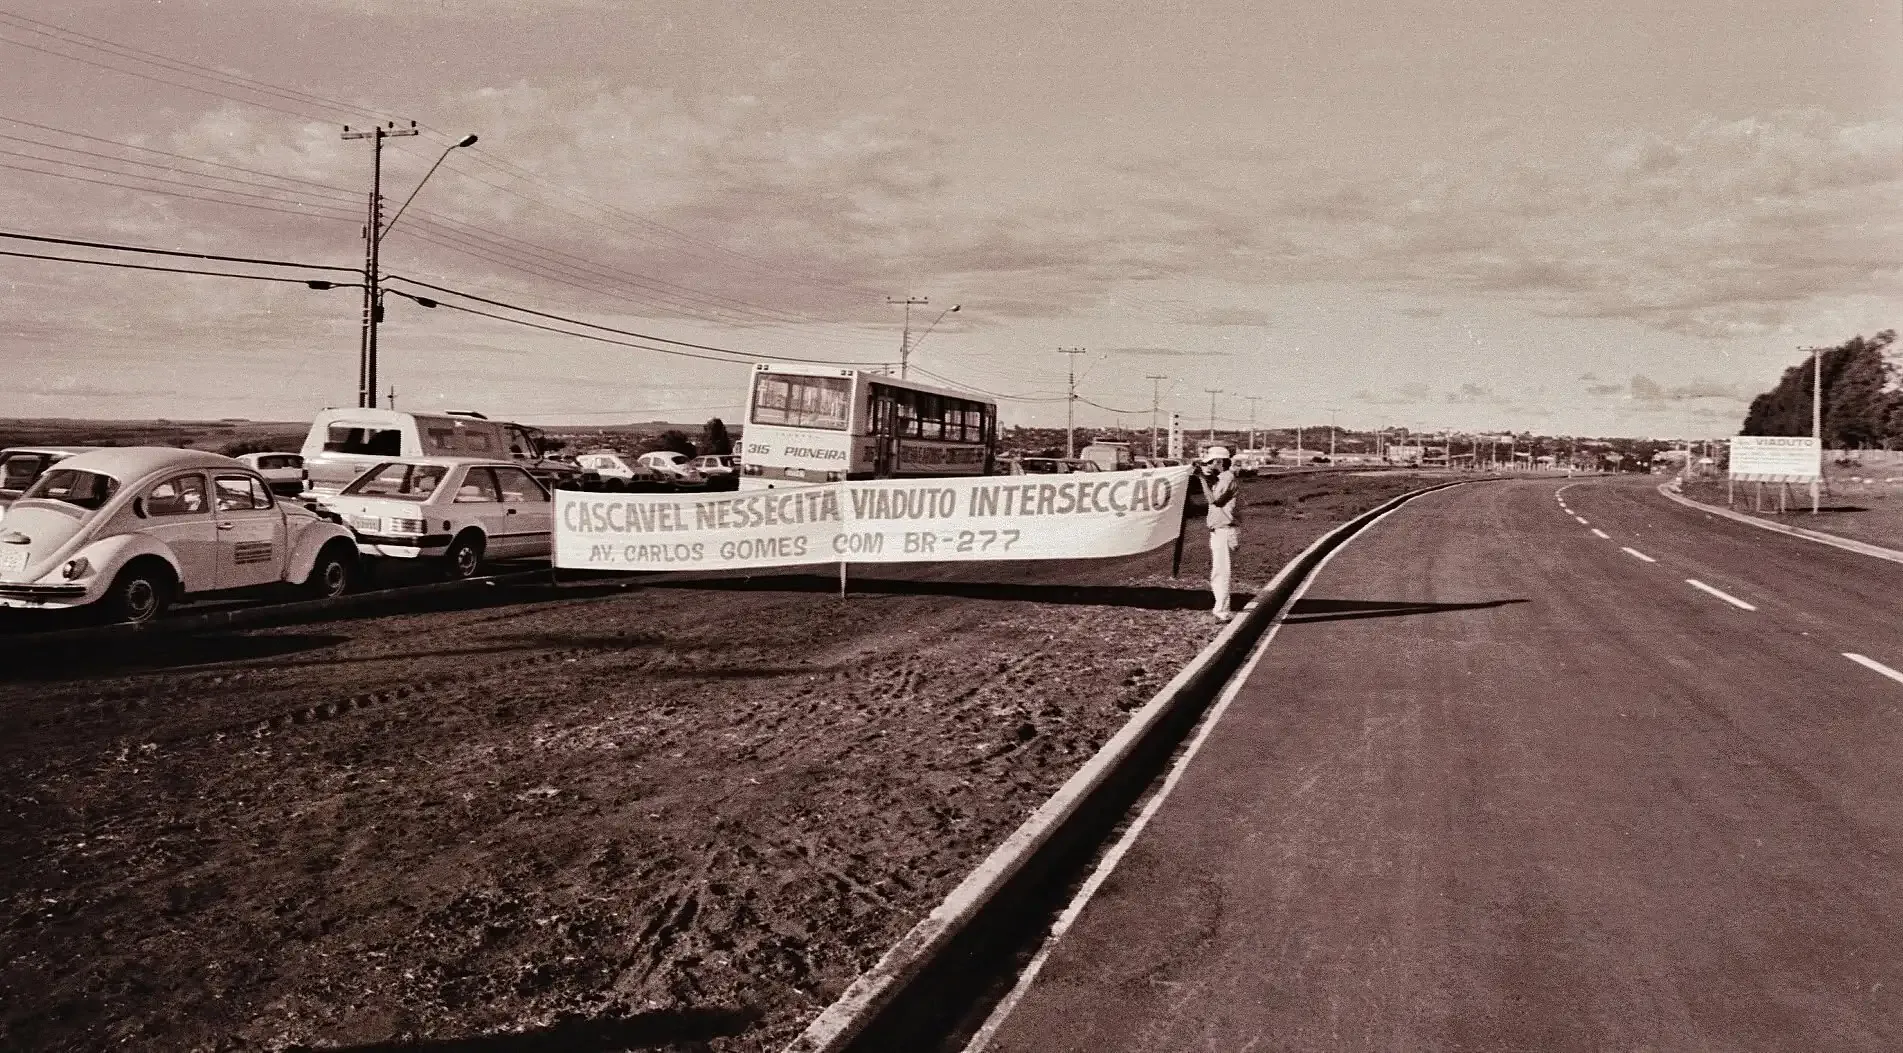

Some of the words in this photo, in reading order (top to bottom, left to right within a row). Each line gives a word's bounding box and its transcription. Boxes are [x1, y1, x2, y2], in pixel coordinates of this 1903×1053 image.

[748, 443, 770, 455] 315
[1756, 438, 1814, 446] VIADUTO
[784, 446, 847, 460] PIONEIRA
[564, 501, 689, 532] CASCAVEL
[695, 490, 840, 530] NESSECITA
[850, 487, 957, 520] VIADUTO
[968, 471, 1172, 518] INTERSECÇÃO
[623, 543, 704, 562] CARLOS
[719, 536, 808, 560] GOMES
[832, 532, 884, 555] COM
[903, 528, 1020, 554] BR-277
